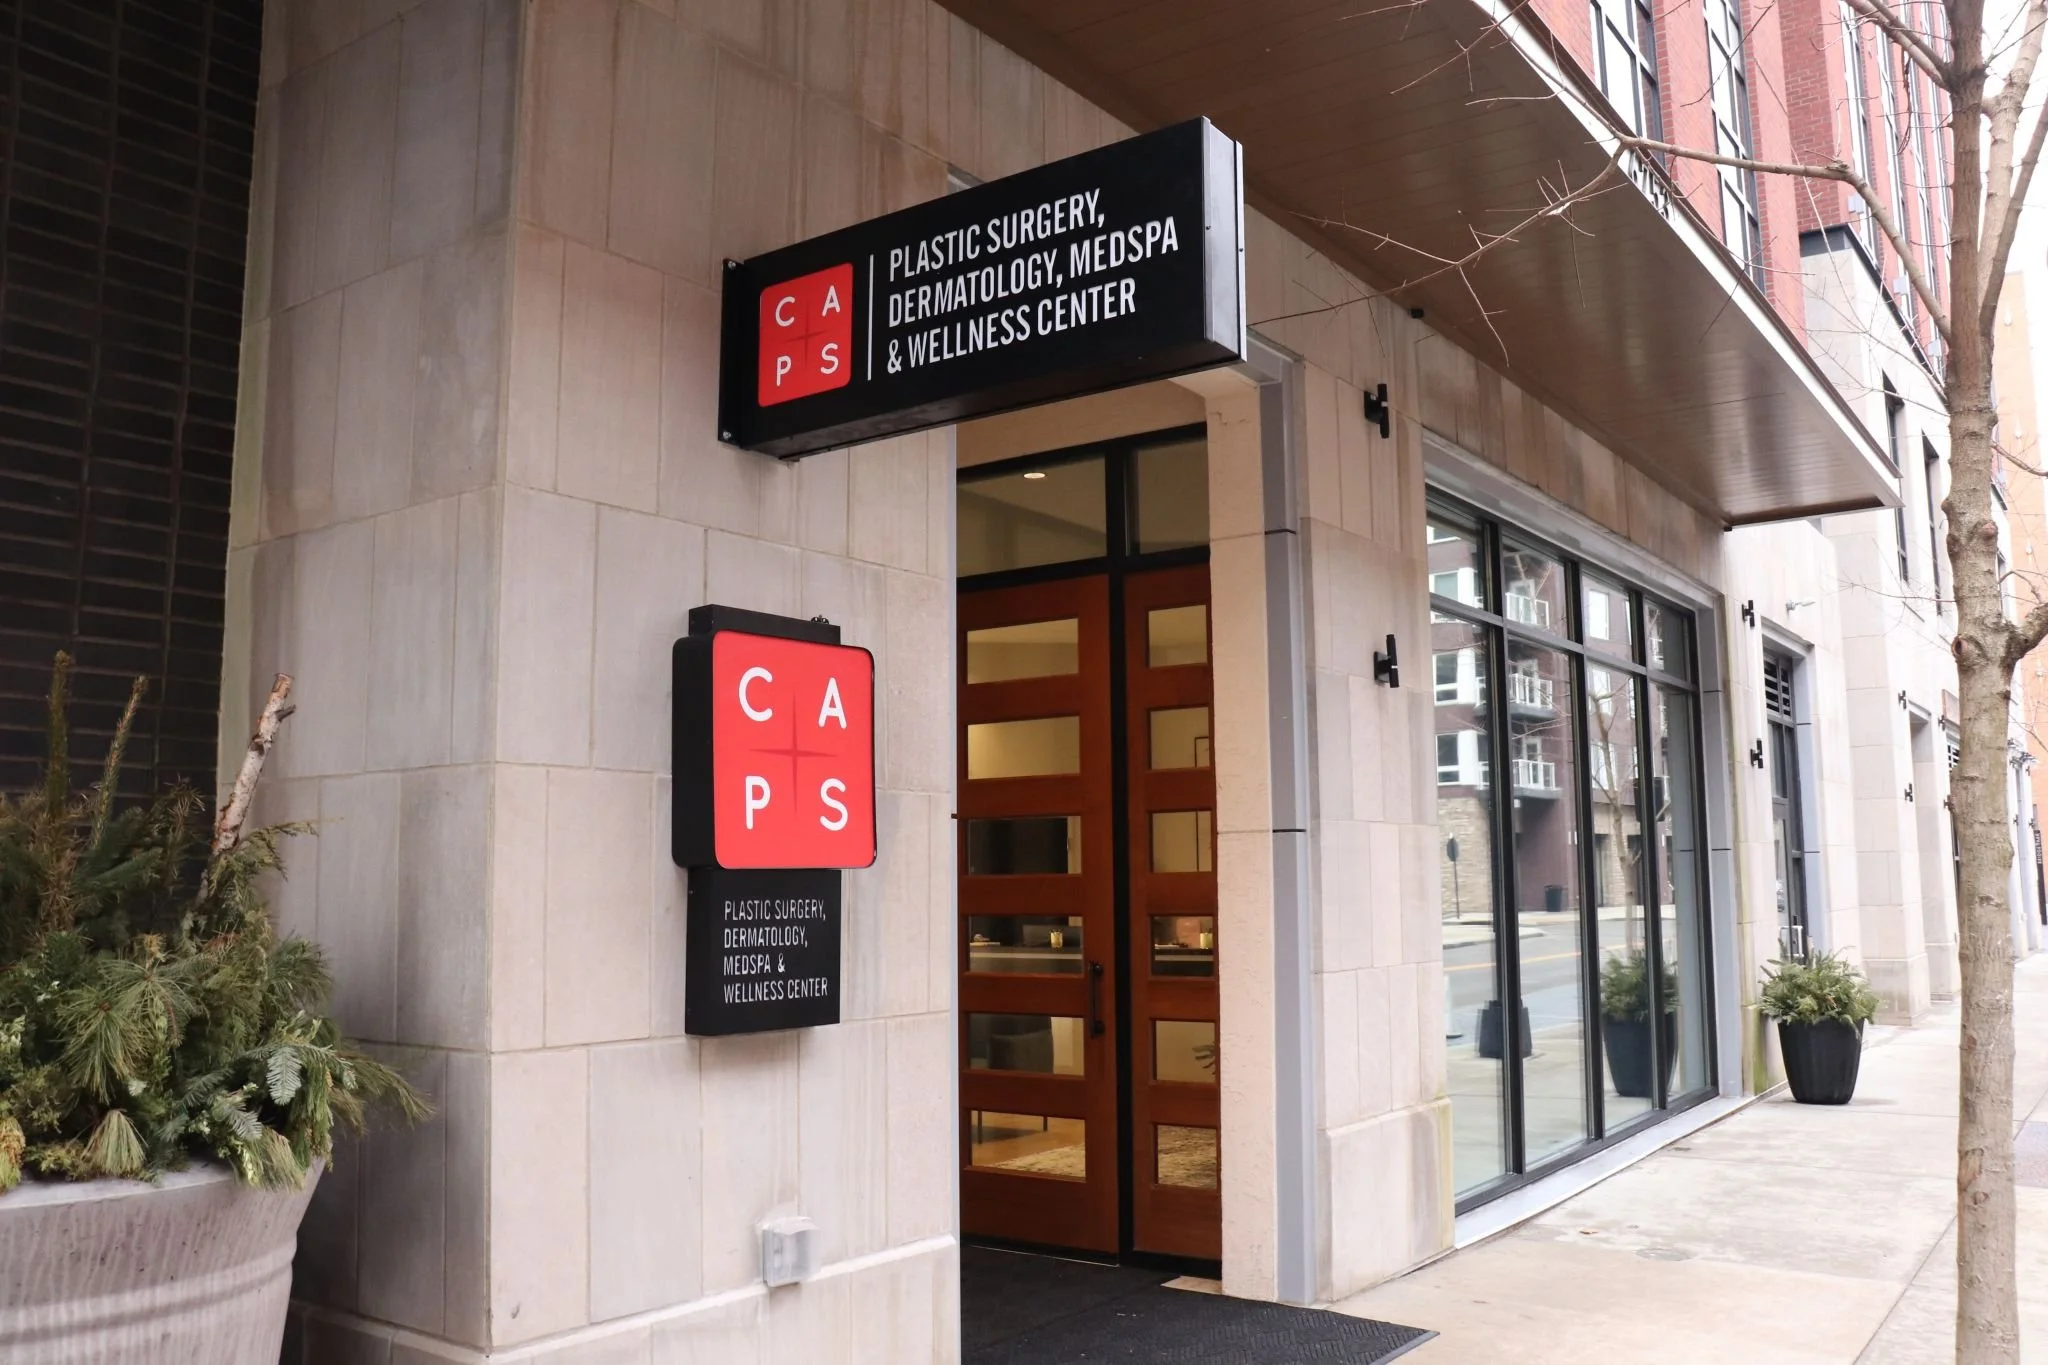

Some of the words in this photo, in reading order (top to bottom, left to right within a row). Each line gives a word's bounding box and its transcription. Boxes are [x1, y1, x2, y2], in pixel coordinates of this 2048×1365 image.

[888, 227, 982, 283] PLASTIC
[986, 187, 1106, 255] SURGERY,
[888, 247, 1063, 329] DERMATOLOGY,
[1069, 215, 1180, 280] MEDSPA
[887, 338, 903, 374] &
[907, 307, 1031, 368] WELLNESS
[1037, 277, 1136, 336] CENTER
[724, 900, 771, 921] PLASTIC
[774, 899, 826, 921] SURGERY,
[724, 925, 808, 949] DERMATOLOGY,
[723, 953, 772, 976] MEDSPA
[777, 953, 786, 973] &
[723, 980, 785, 1004] WELLNESS
[787, 977, 828, 999] CENTER
